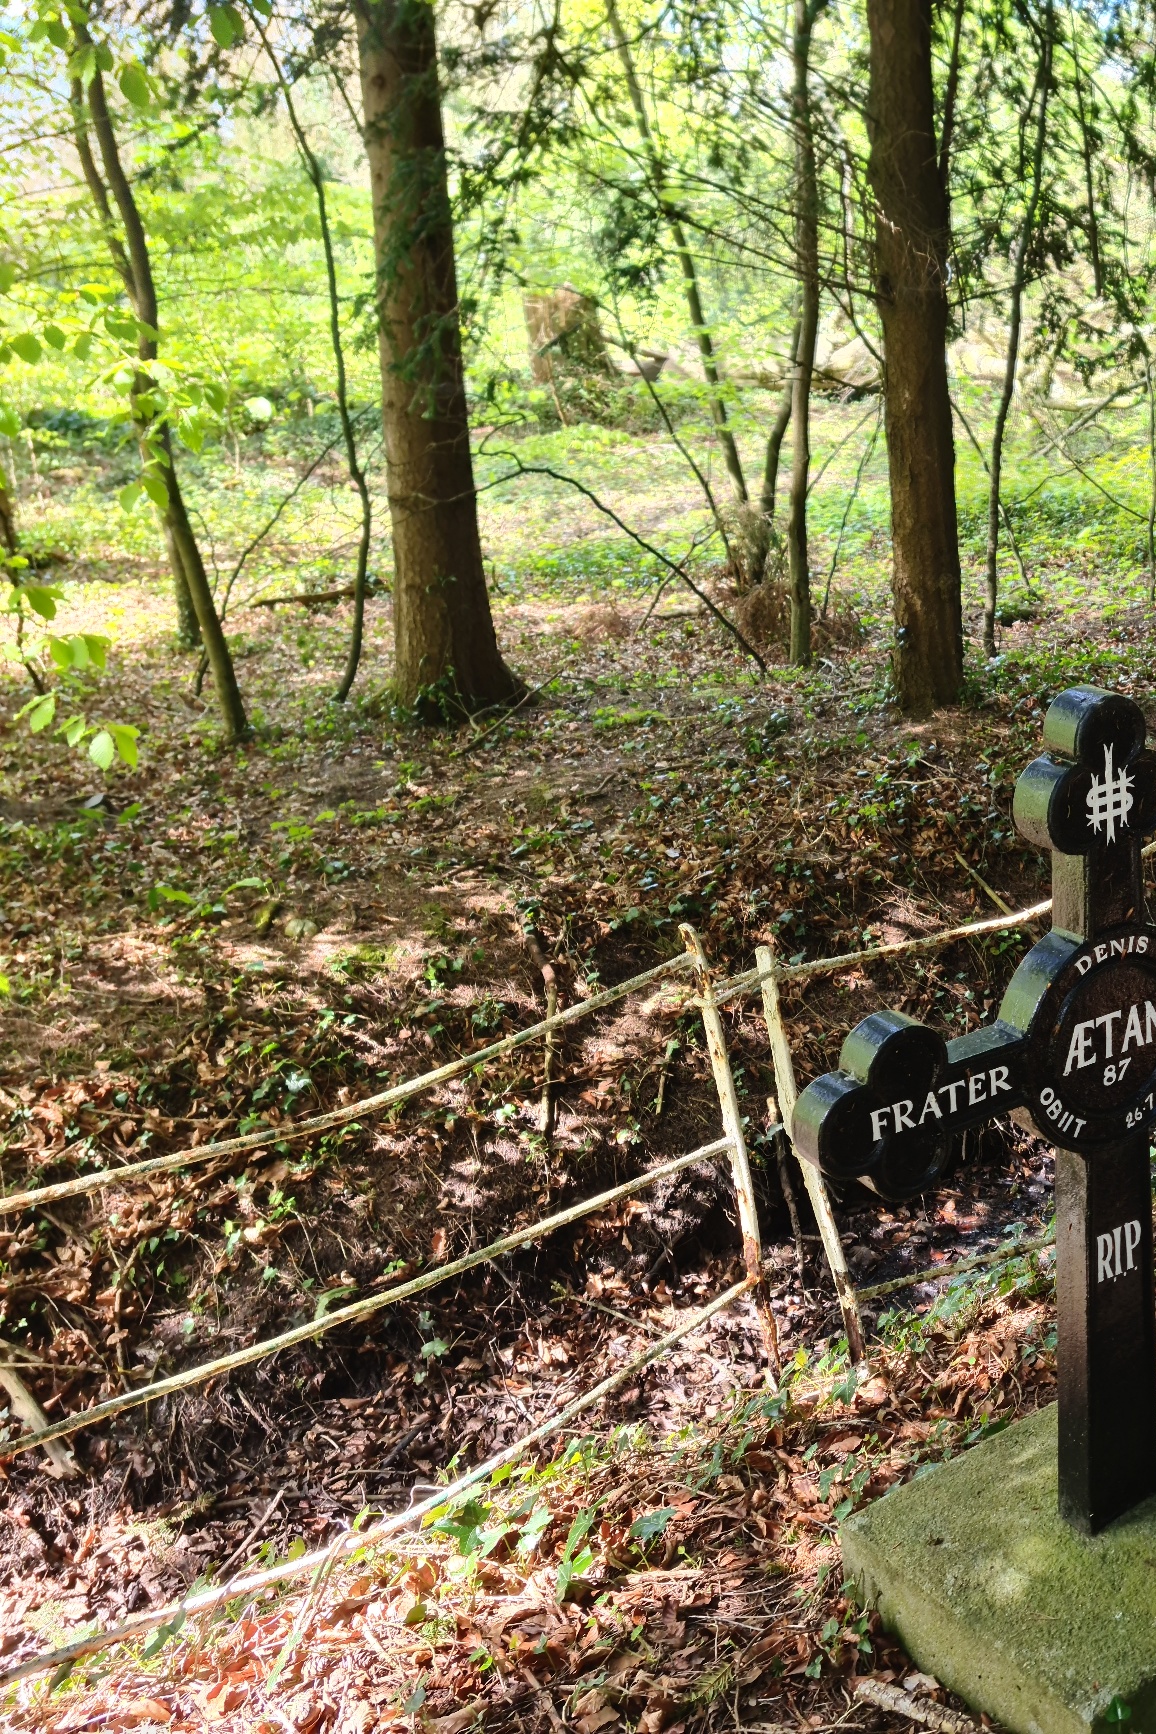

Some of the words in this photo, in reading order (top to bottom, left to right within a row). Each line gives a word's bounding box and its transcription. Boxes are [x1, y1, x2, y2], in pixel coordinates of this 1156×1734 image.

[1074, 935, 1149, 976] DENIS
[1103, 1057, 1132, 1087] 87
[869, 1065, 1013, 1142] FRATER
[1039, 1087, 1087, 1139] OBIIT
